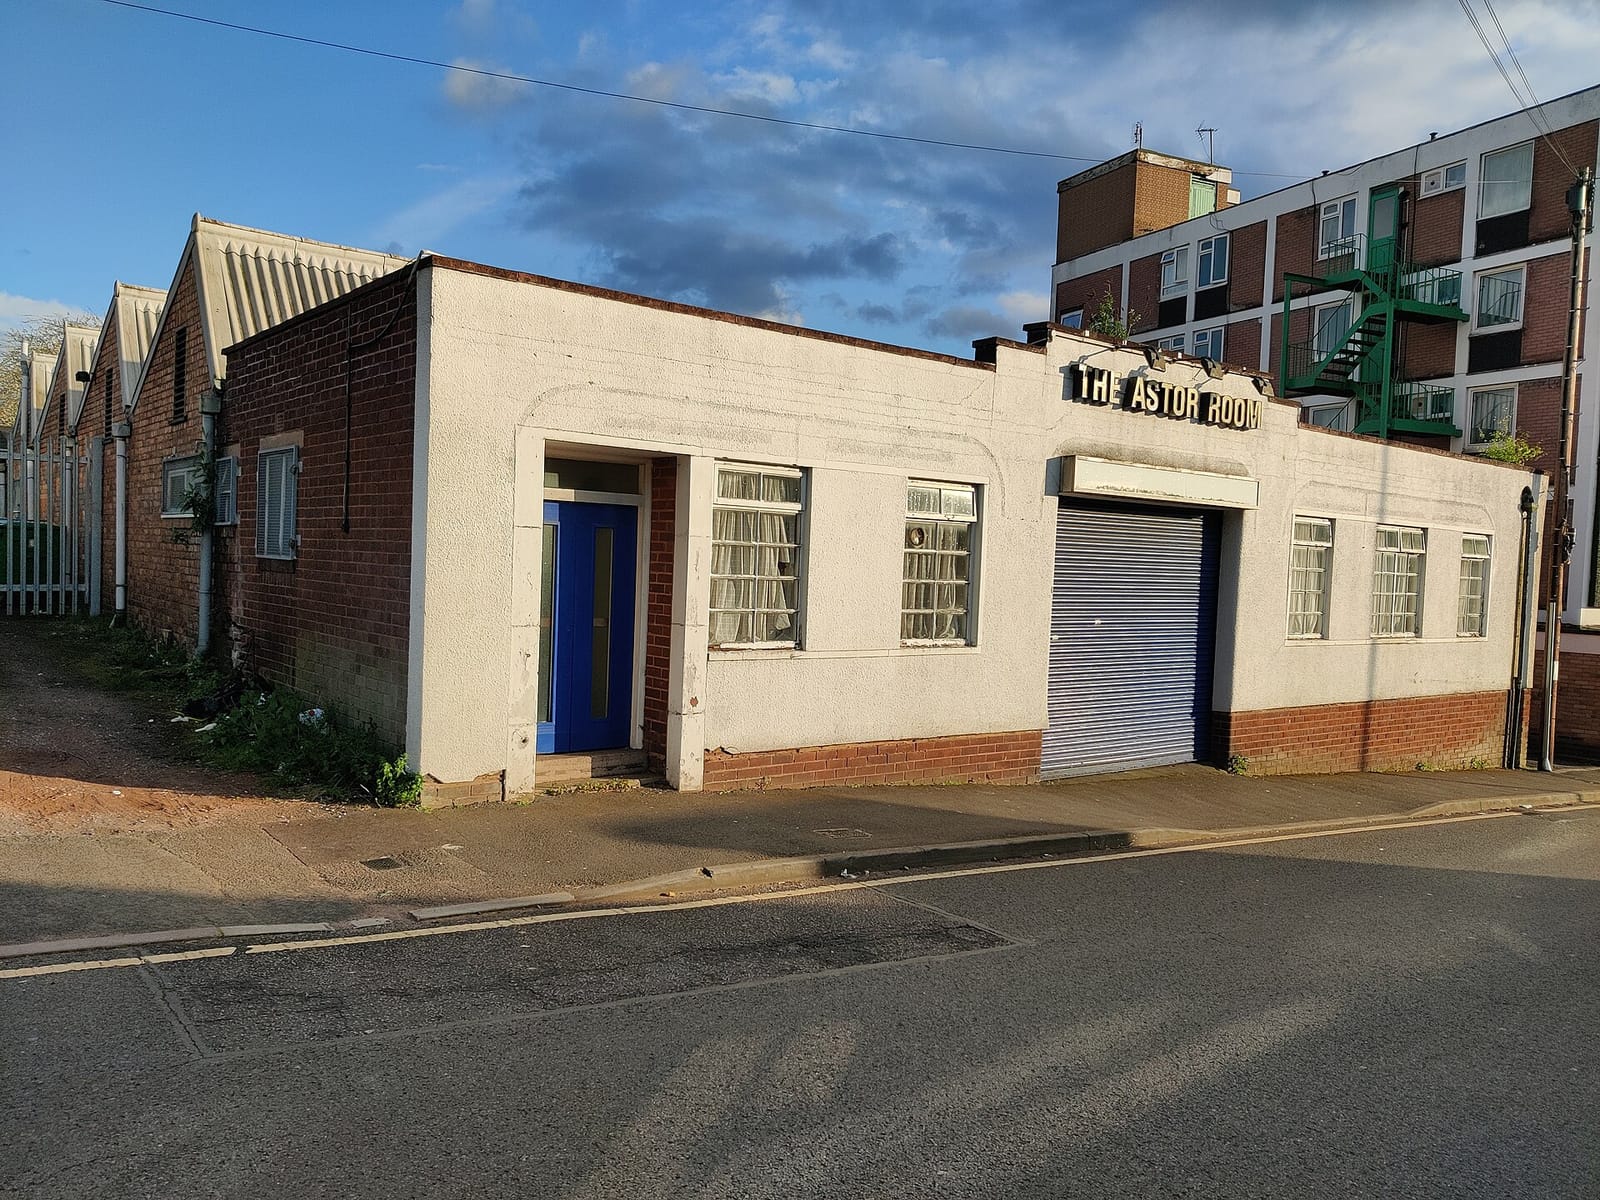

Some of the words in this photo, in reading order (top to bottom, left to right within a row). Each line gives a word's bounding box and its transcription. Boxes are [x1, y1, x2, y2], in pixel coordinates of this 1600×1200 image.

[1076, 363, 1122, 405] THE
[1130, 376, 1199, 418] ASTOR
[1207, 392, 1263, 429] ROOM
